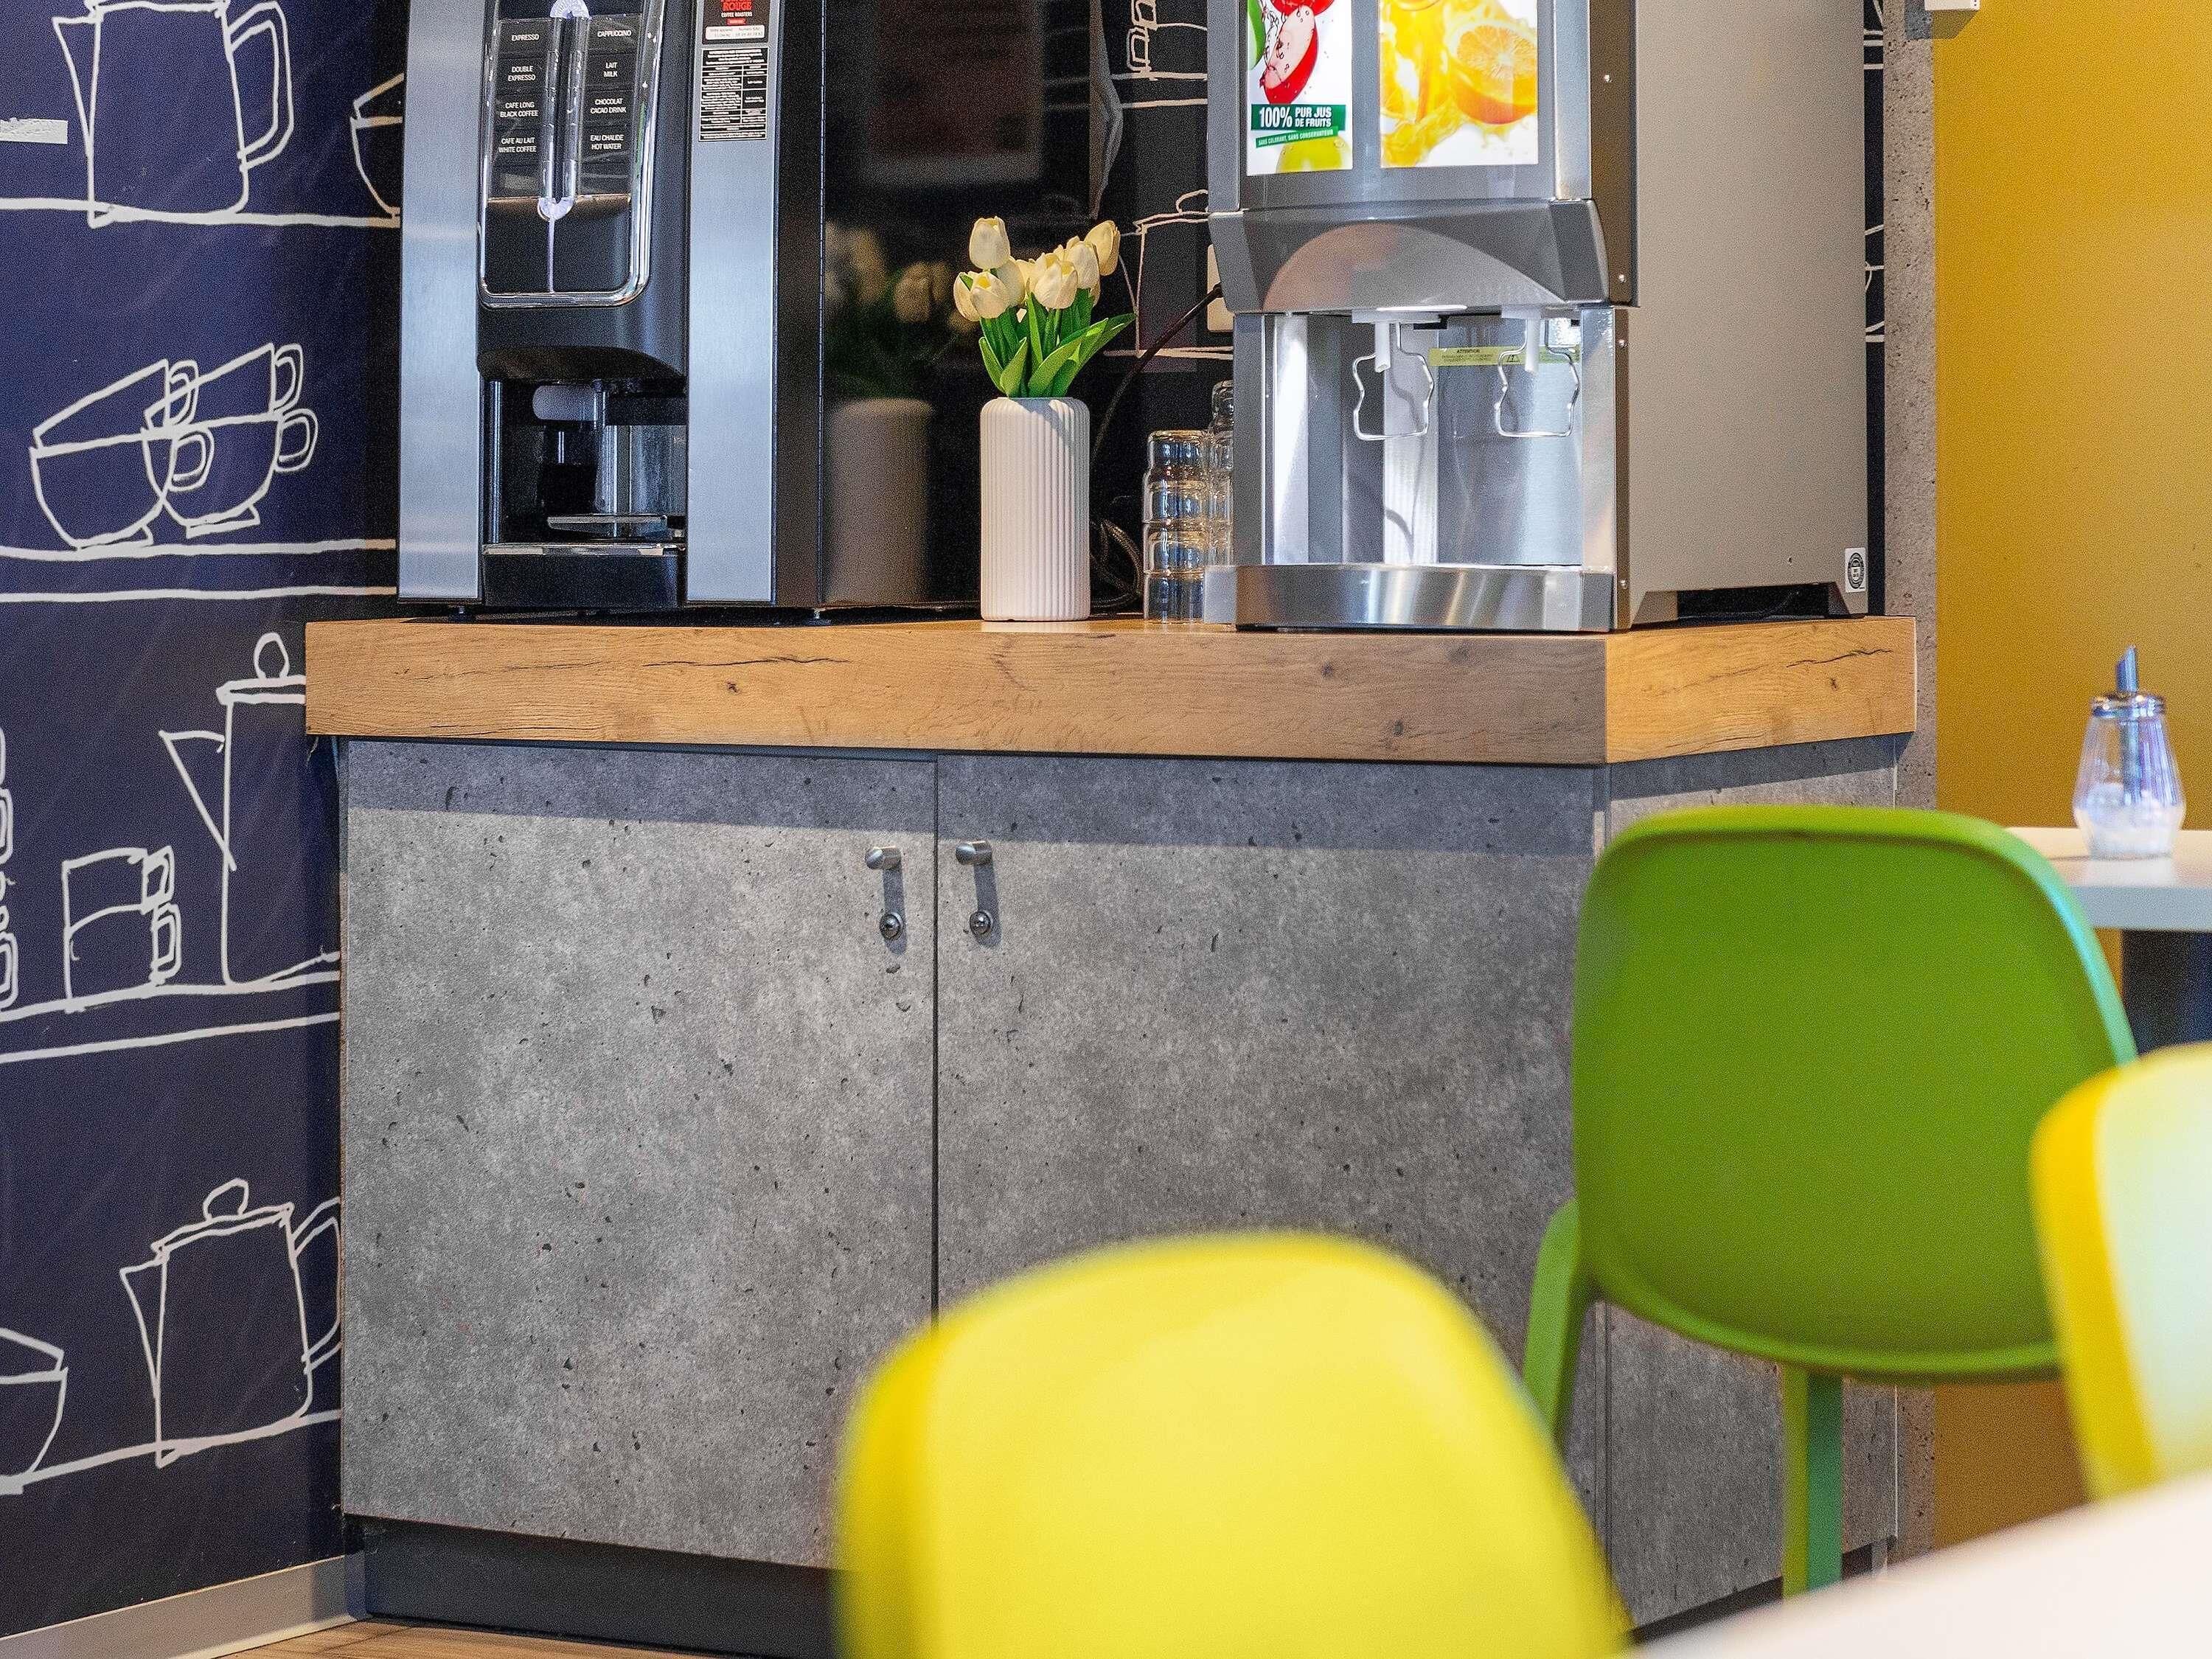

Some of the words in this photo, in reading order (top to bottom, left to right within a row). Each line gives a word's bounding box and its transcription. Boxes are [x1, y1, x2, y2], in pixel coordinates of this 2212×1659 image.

[1259, 107, 1293, 128] 100%
[1295, 107, 1312, 118] PUR
[1314, 107, 1332, 118] JUS
[1295, 118, 1305, 128] DE
[1305, 118, 1332, 128] FRUITS
